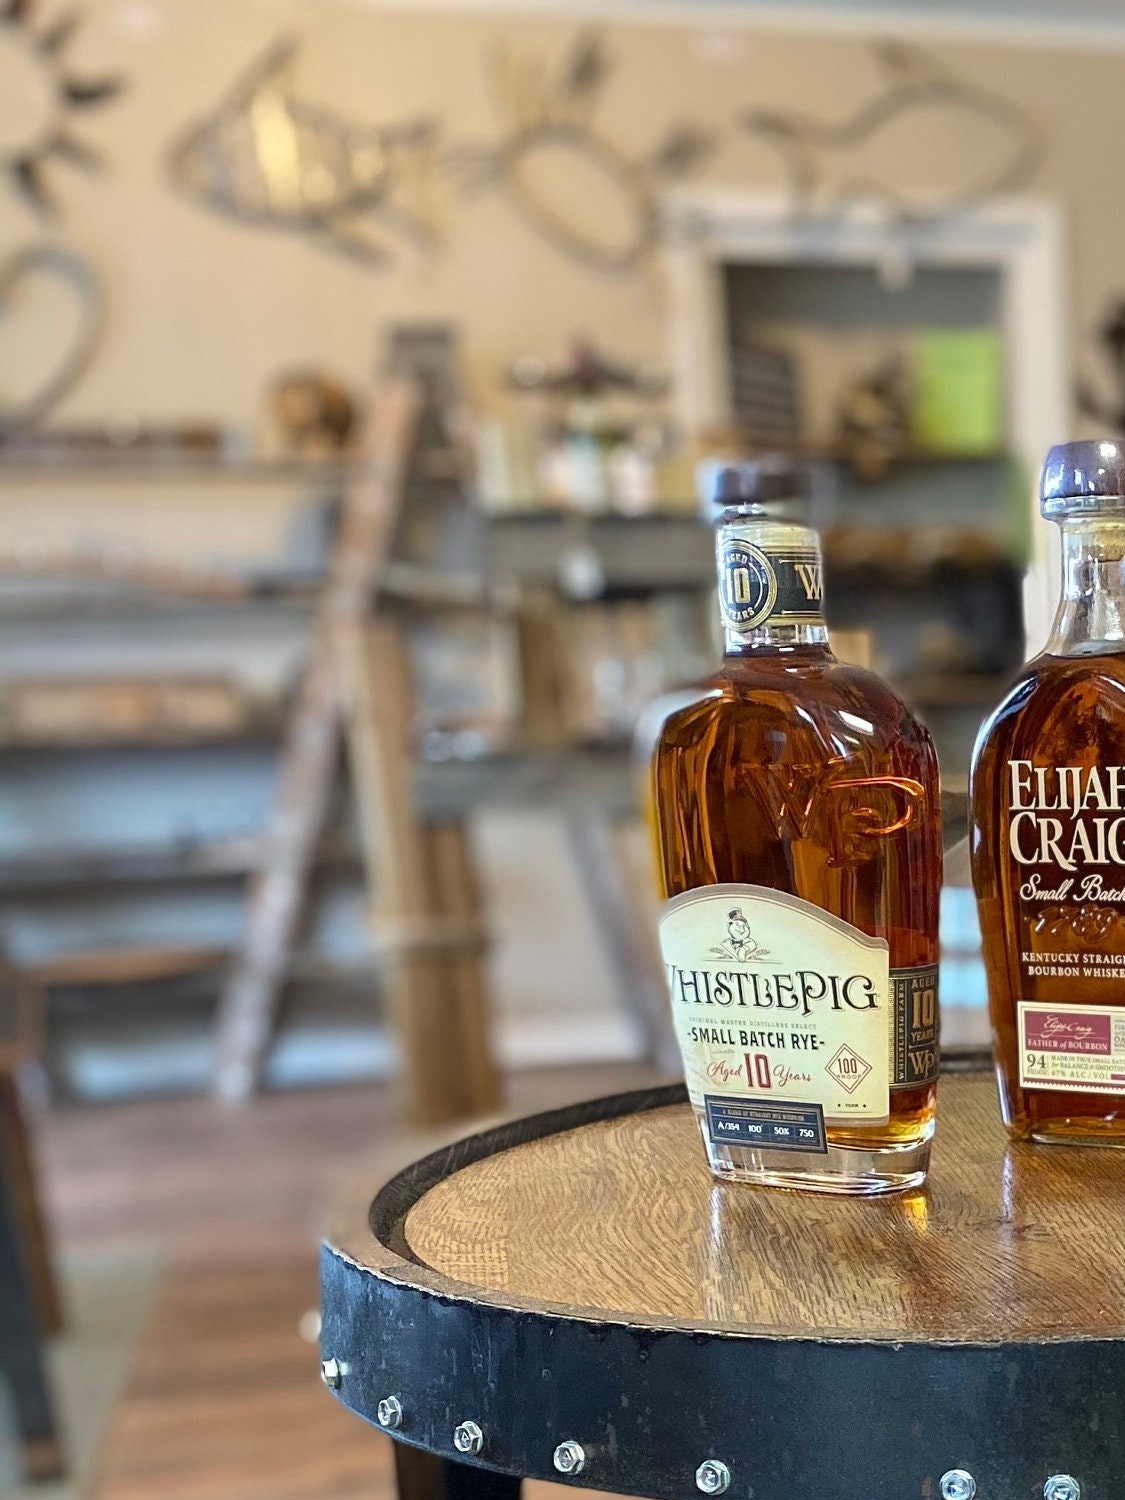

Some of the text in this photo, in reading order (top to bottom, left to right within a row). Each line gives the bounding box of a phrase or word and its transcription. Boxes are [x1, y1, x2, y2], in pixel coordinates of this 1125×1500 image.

[726, 567, 751, 604] 10
[1020, 873, 1074, 901] Small
[1022, 952, 1080, 964] KENTUCKY
[1028, 965, 1080, 977] BOURBON
[912, 988, 935, 1029] 10
[739, 1030, 785, 1049] BATCH
[1027, 1038, 1108, 1051] FATHER of BOURBON
[837, 1058, 858, 1074] 100
[1026, 1053, 1047, 1069] 94
[706, 1053, 812, 1089] Aged 10 Years
[773, 1127, 790, 1136] 50%
[799, 1128, 815, 1138] 750
